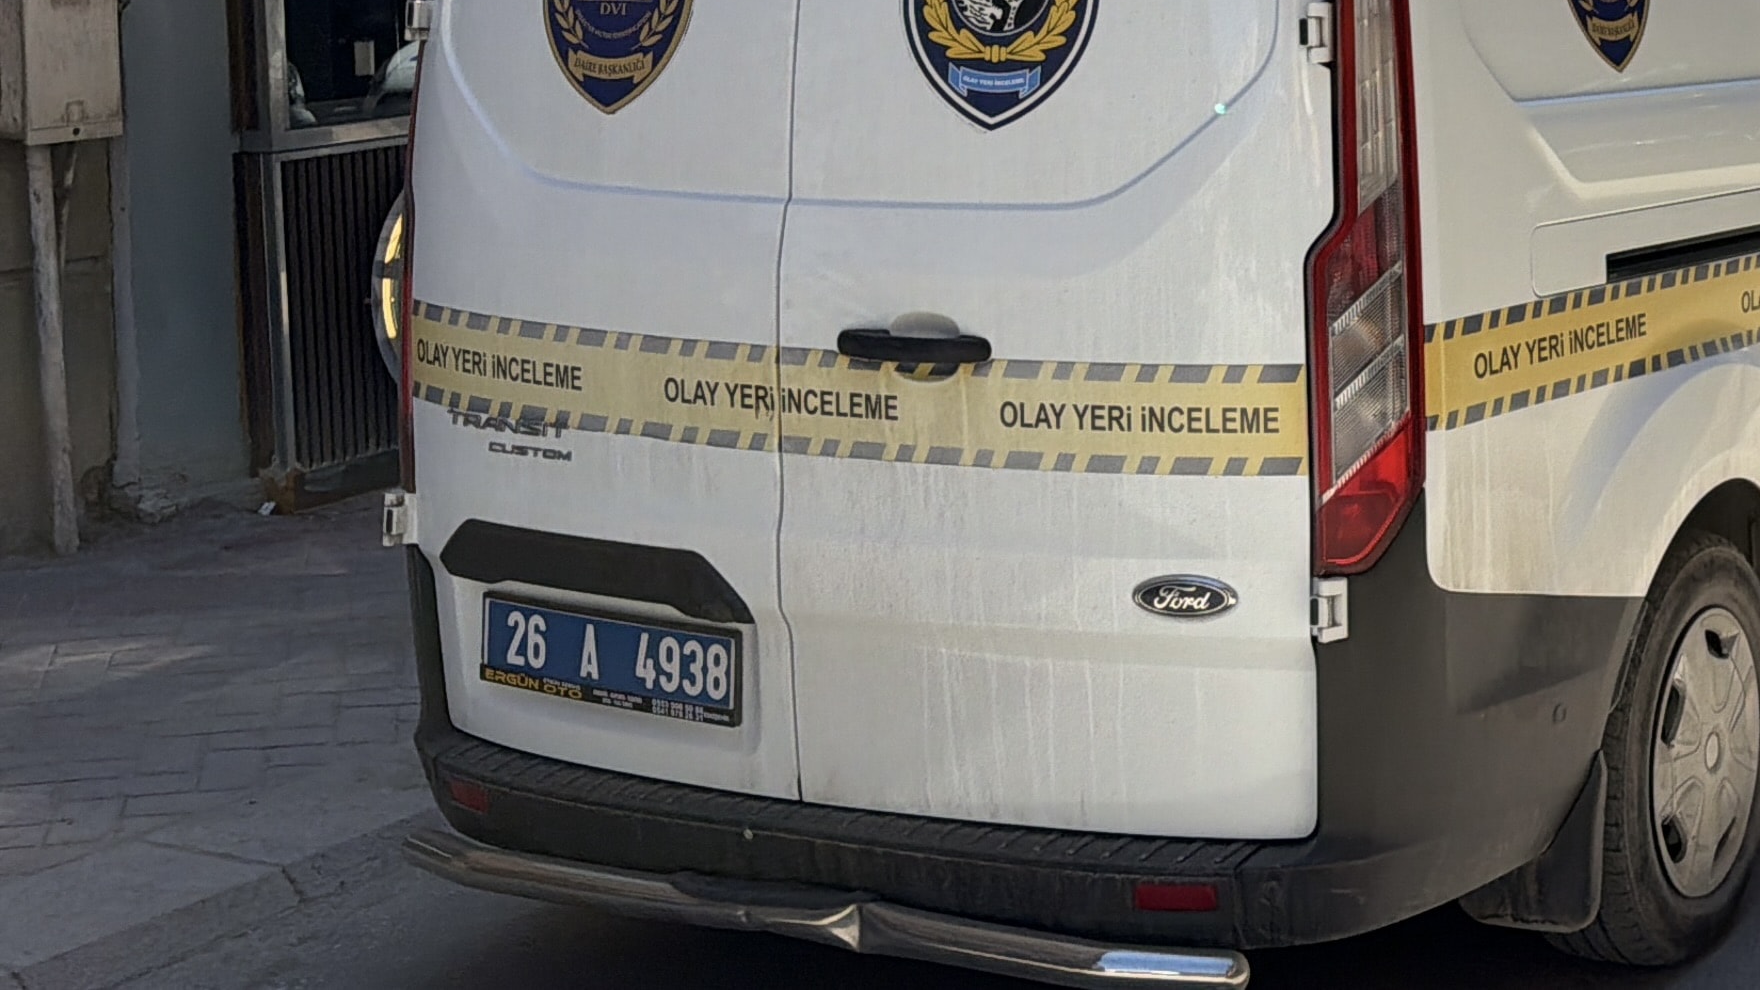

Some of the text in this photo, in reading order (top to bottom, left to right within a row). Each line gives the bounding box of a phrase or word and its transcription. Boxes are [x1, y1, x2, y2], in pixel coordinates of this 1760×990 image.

[600, 2, 627, 16] DVI
[417, 338, 449, 367] OLAY
[1473, 341, 1522, 379] OLAY
[664, 377, 720, 406] OLAY
[448, 407, 571, 439] TRANSIT
[1000, 400, 1066, 430] OLAY
[488, 442, 572, 461] CUSTOM
[1153, 585, 1211, 610] Ford
[506, 610, 728, 701] 26 A 4938
[484, 667, 540, 691] ERGÜN
[543, 683, 583, 700] OTO
